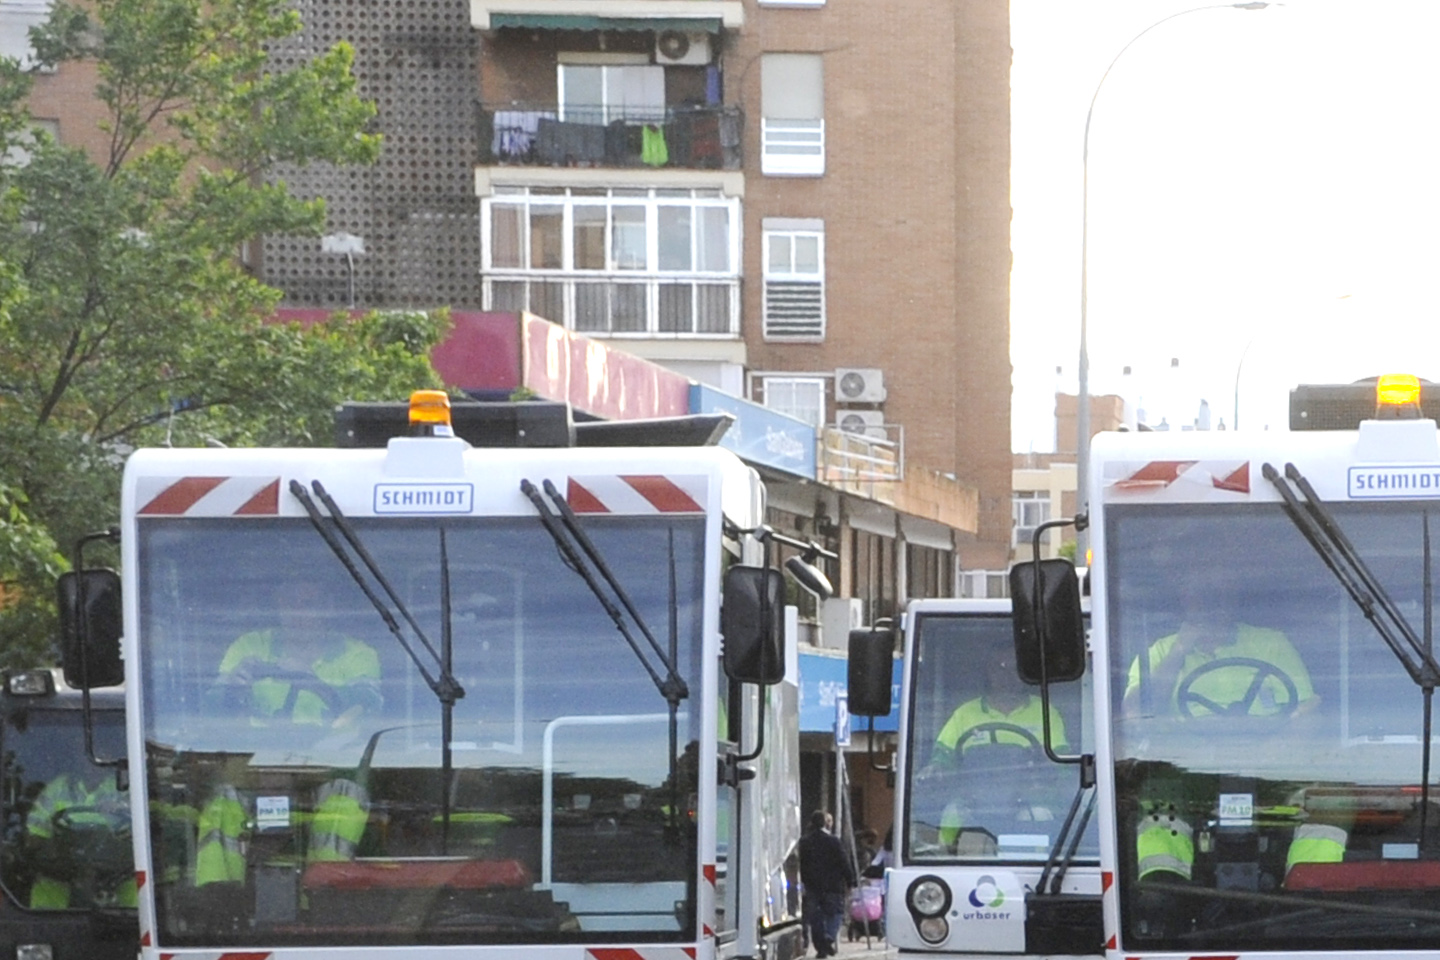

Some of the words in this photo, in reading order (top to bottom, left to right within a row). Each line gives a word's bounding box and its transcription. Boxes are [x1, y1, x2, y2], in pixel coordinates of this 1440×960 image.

[381, 490, 465, 506] SCHMIDT
[1222, 805, 1237, 815] PM
[1240, 805, 1251, 815] 10
